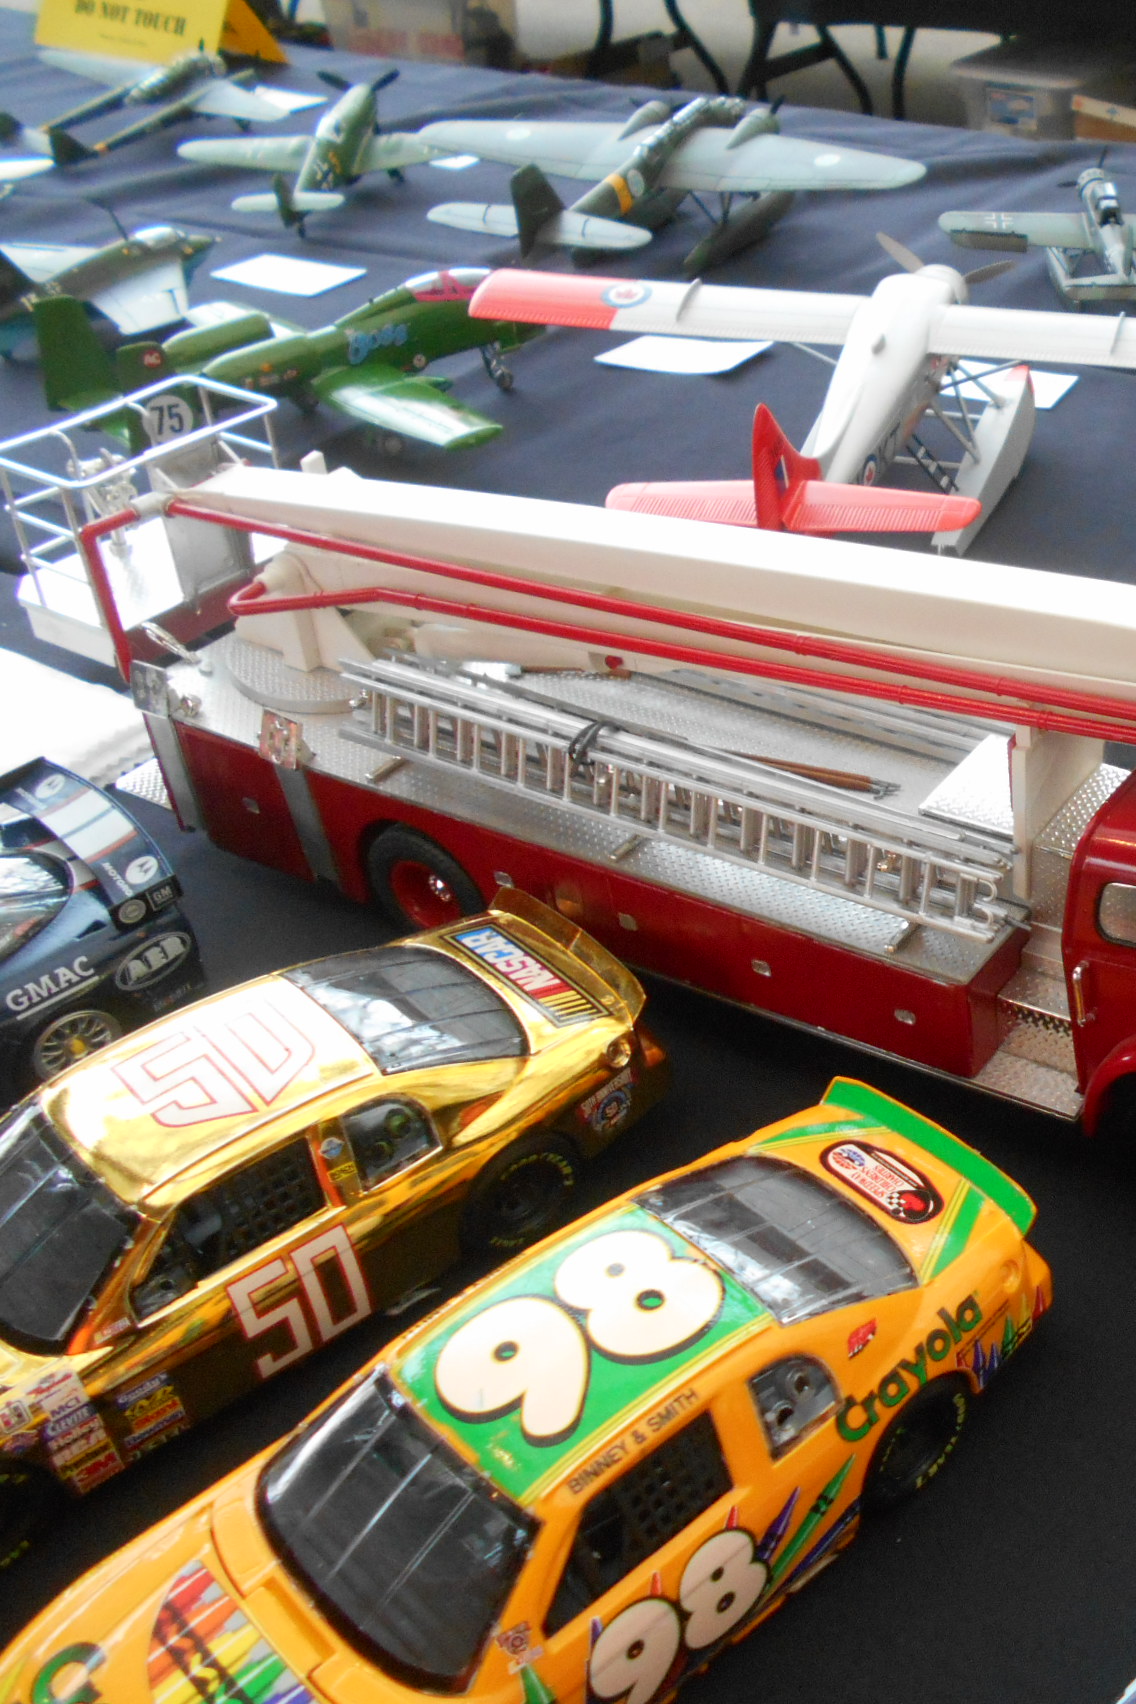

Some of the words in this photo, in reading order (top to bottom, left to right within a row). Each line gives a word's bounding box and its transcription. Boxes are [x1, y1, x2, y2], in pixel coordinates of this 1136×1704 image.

[100, 1, 131, 24] NOT
[134, 8, 187, 36] TOUCH
[151, 403, 184, 436] 75
[5, 955, 95, 1011] GMAC
[461, 928, 562, 991] NASCAR
[226, 1223, 373, 1380] 50
[435, 1229, 725, 1447] 98
[835, 1294, 983, 1442] Crayola
[567, 1440, 629, 1495] BINNEY
[631, 1429, 648, 1445] &
[647, 1387, 699, 1433] SMITH
[589, 1528, 771, 1704] 98
